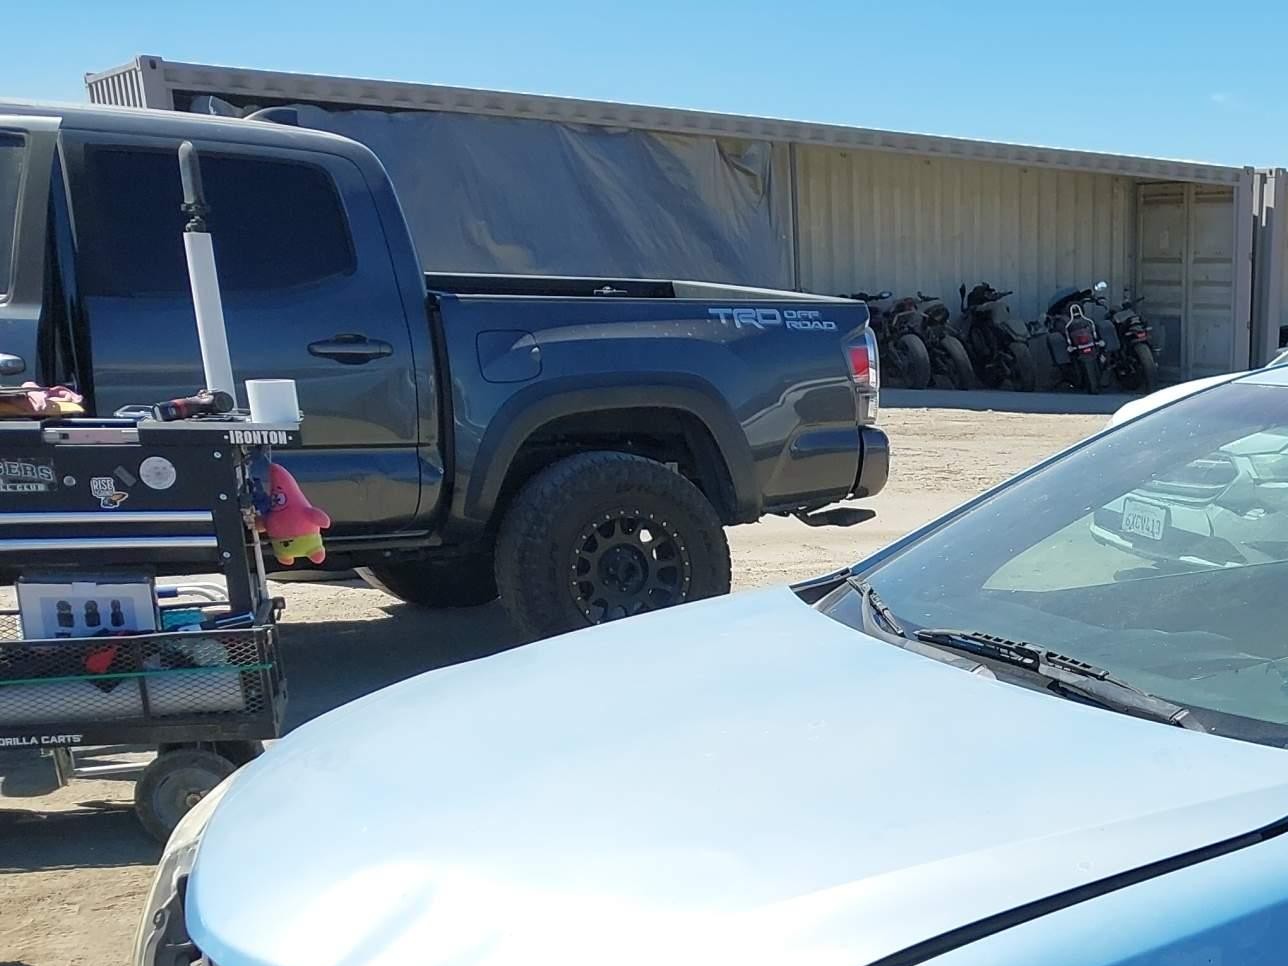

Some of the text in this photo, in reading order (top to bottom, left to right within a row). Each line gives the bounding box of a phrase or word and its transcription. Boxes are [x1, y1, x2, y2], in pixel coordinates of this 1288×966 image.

[708, 308, 782, 329] TRD
[783, 310, 820, 319] OFF
[785, 320, 837, 330] ROAD
[228, 430, 288, 445] IRONTON
[41, 734, 82, 744] CARTS
